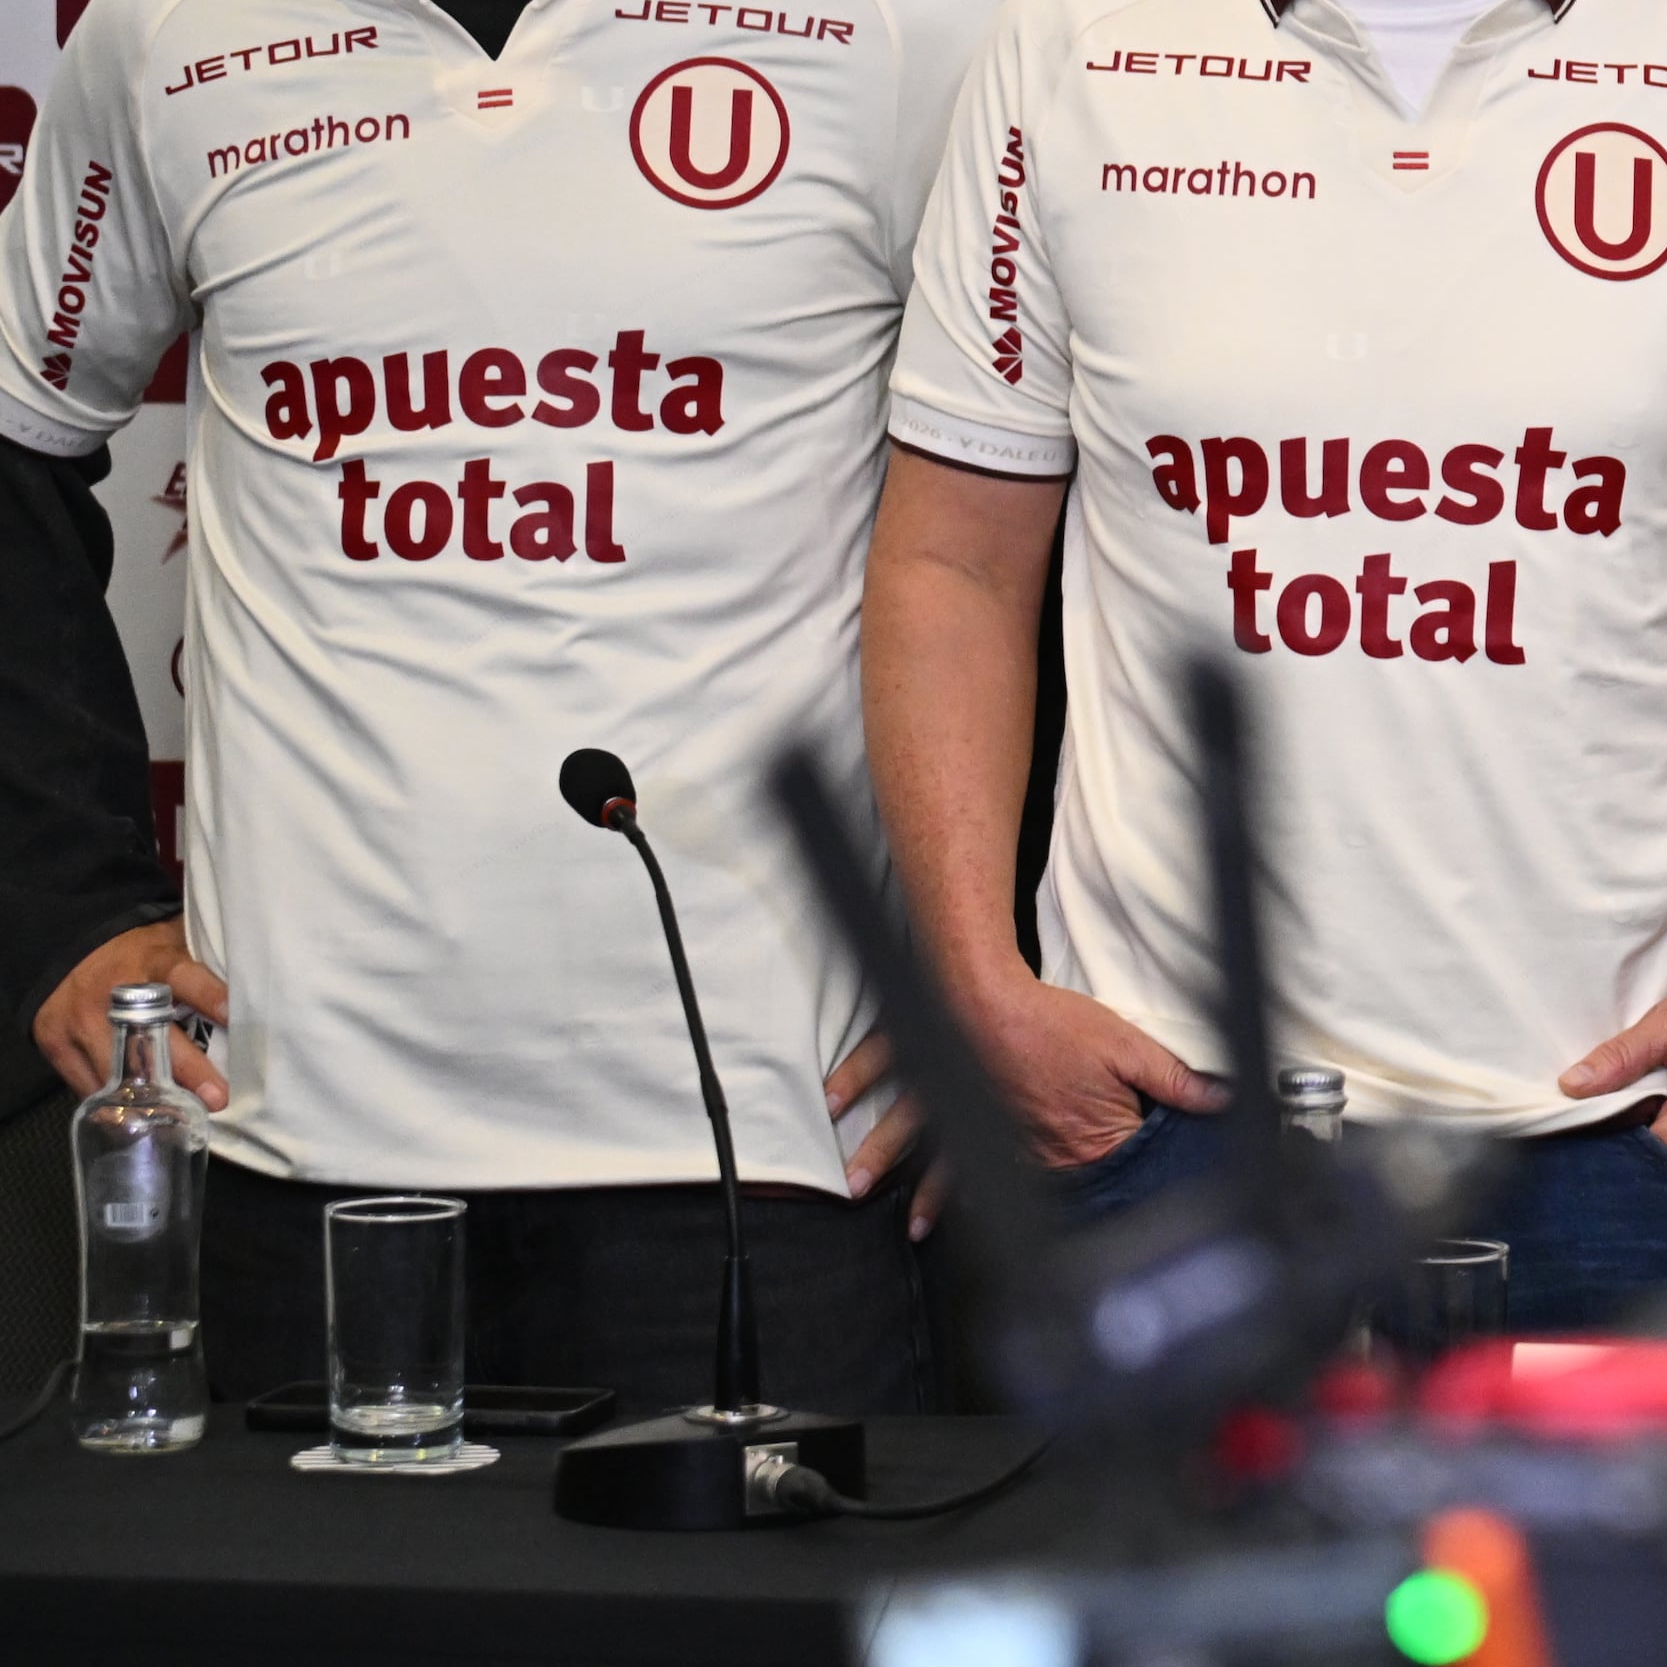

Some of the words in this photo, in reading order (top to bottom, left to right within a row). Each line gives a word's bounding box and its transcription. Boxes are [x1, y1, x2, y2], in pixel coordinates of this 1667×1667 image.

[165, 26, 379, 95] JETOUR
[1086, 49, 1313, 84] JETOUR
[207, 113, 410, 178] marathon
[669, 85, 753, 190] U
[1101, 161, 1317, 200] marathon
[47, 161, 112, 349] MOVISUN
[989, 125, 1027, 323] MOVISUN
[1573, 151, 1654, 261] U
[261, 329, 725, 462] apuesta
[339, 458, 627, 563] total
[1145, 426, 1628, 545] apuesta
[1226, 547, 1528, 666] total
